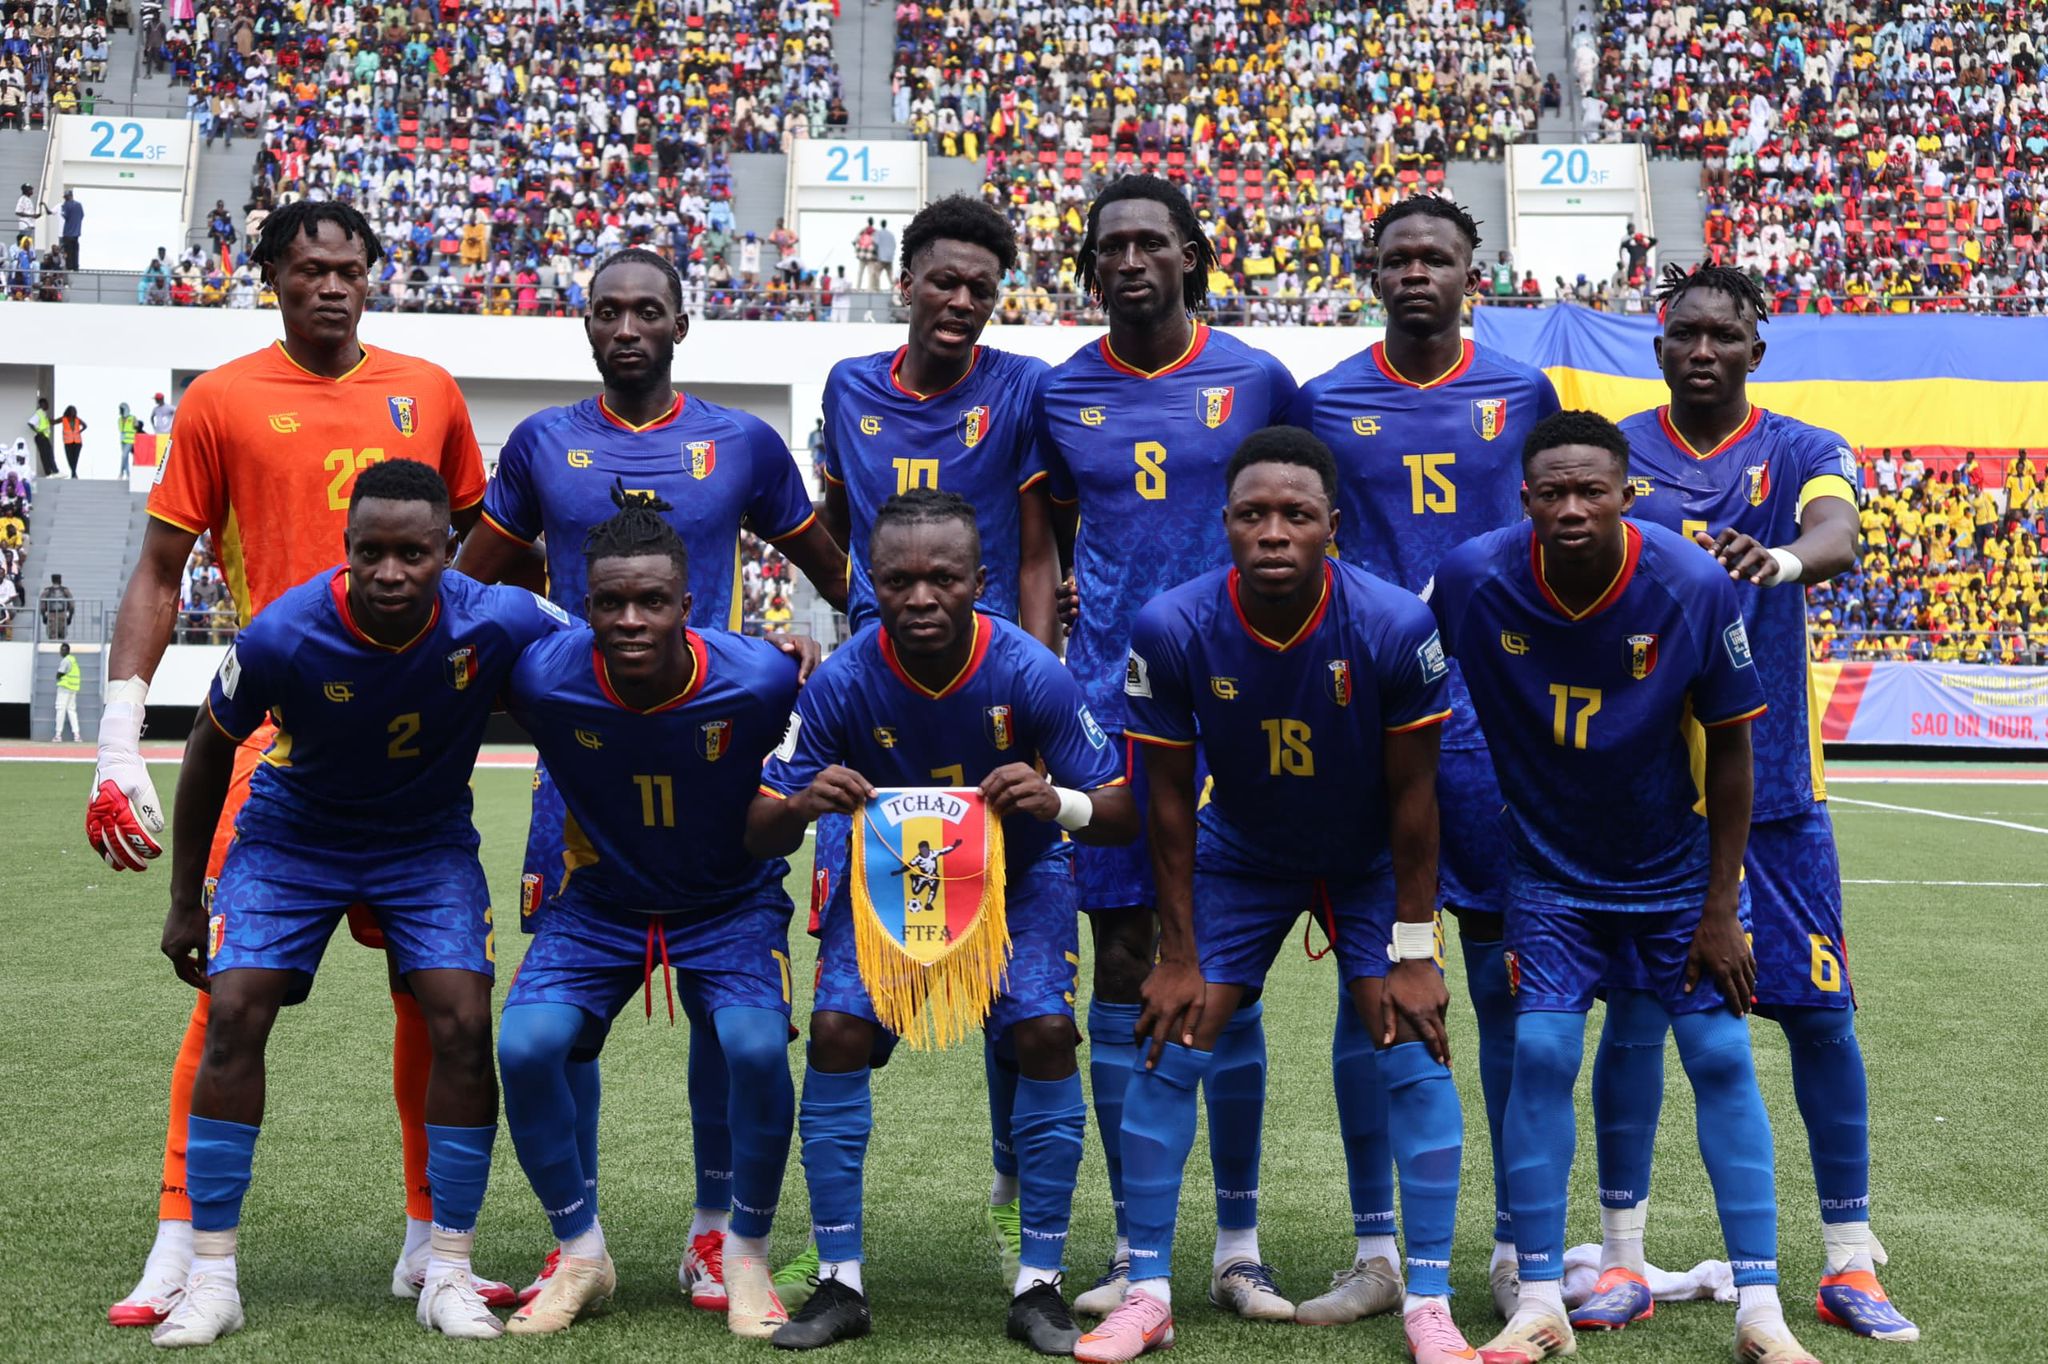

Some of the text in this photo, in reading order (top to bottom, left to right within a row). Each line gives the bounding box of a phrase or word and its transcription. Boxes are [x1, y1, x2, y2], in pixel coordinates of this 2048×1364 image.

[90, 121, 167, 160] 22 3F
[826, 146, 890, 182] 21 3F
[1540, 149, 1609, 184] 20 3F
[1135, 441, 1167, 500] 8
[1402, 453, 1457, 514] 15
[388, 712, 421, 758] 2
[1549, 683, 1603, 750] 17
[1911, 712, 2038, 741] SAO UN JOUR,
[1261, 718, 1315, 777] 18
[633, 775, 675, 827] 11
[888, 795, 961, 817] TCHAD
[901, 925, 953, 942] FTFA
[1807, 933, 1841, 993] 6
